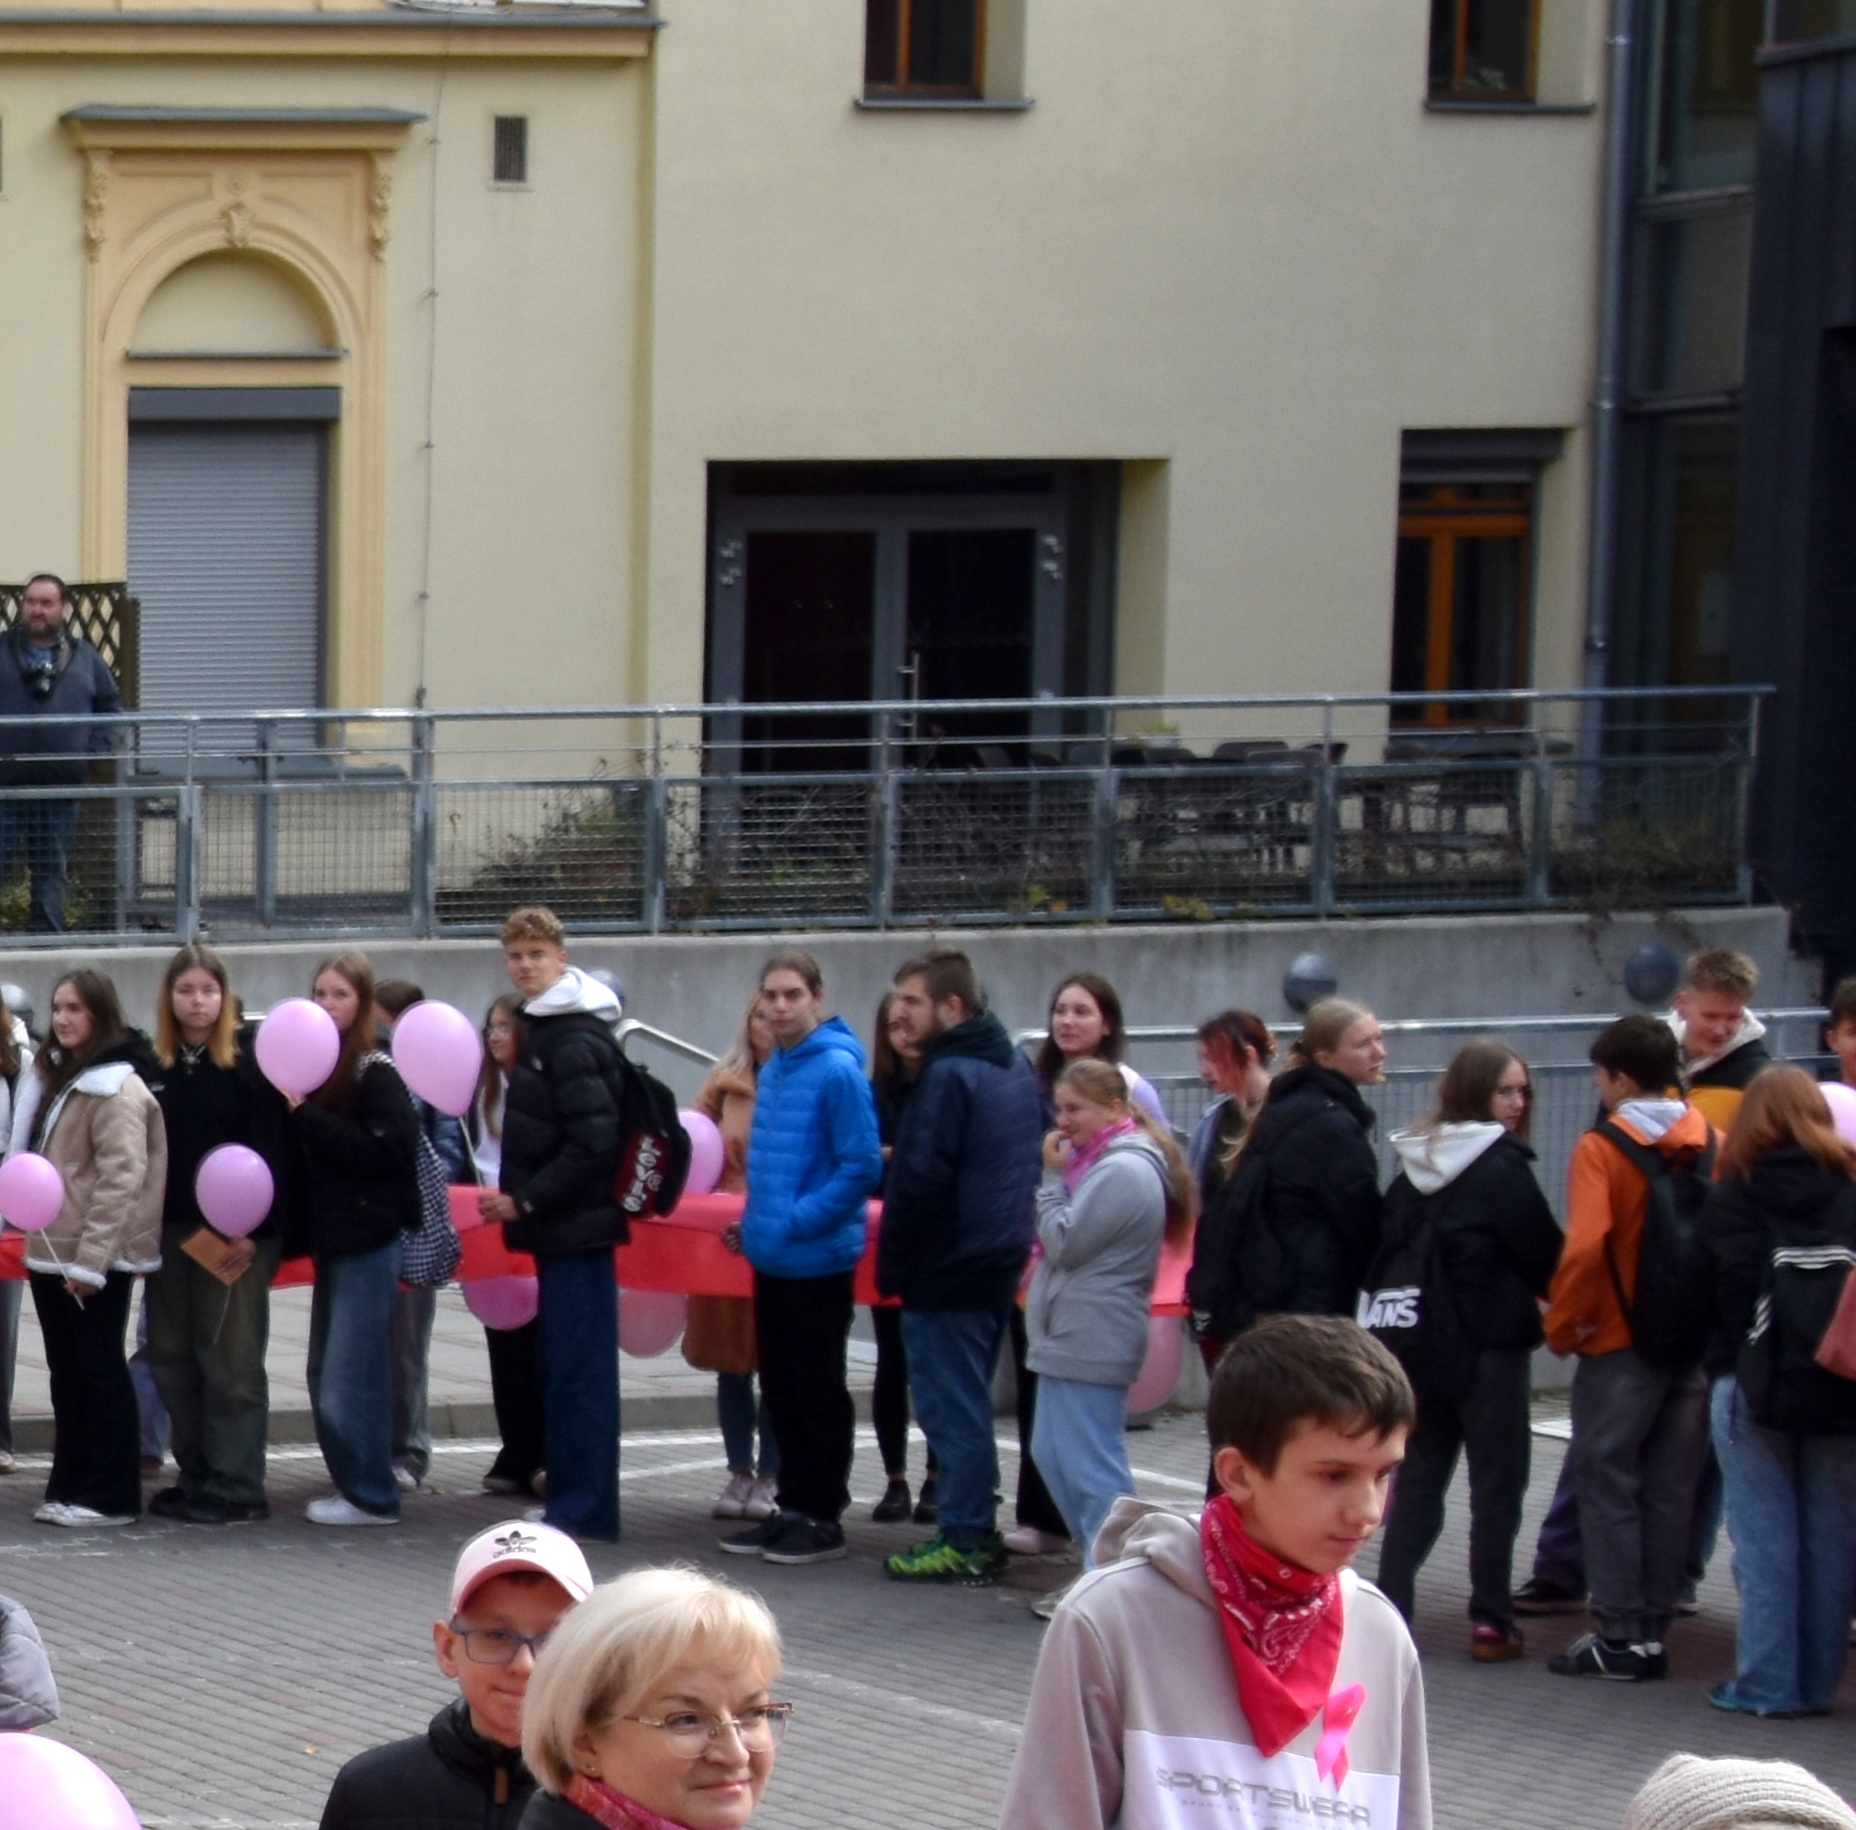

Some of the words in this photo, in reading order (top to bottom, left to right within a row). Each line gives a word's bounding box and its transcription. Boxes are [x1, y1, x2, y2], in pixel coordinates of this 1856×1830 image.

[1357, 1287, 1420, 1328] VANS
[493, 1546, 536, 1558] adidas
[1157, 1767, 1371, 1826] SPORTSWEAR
